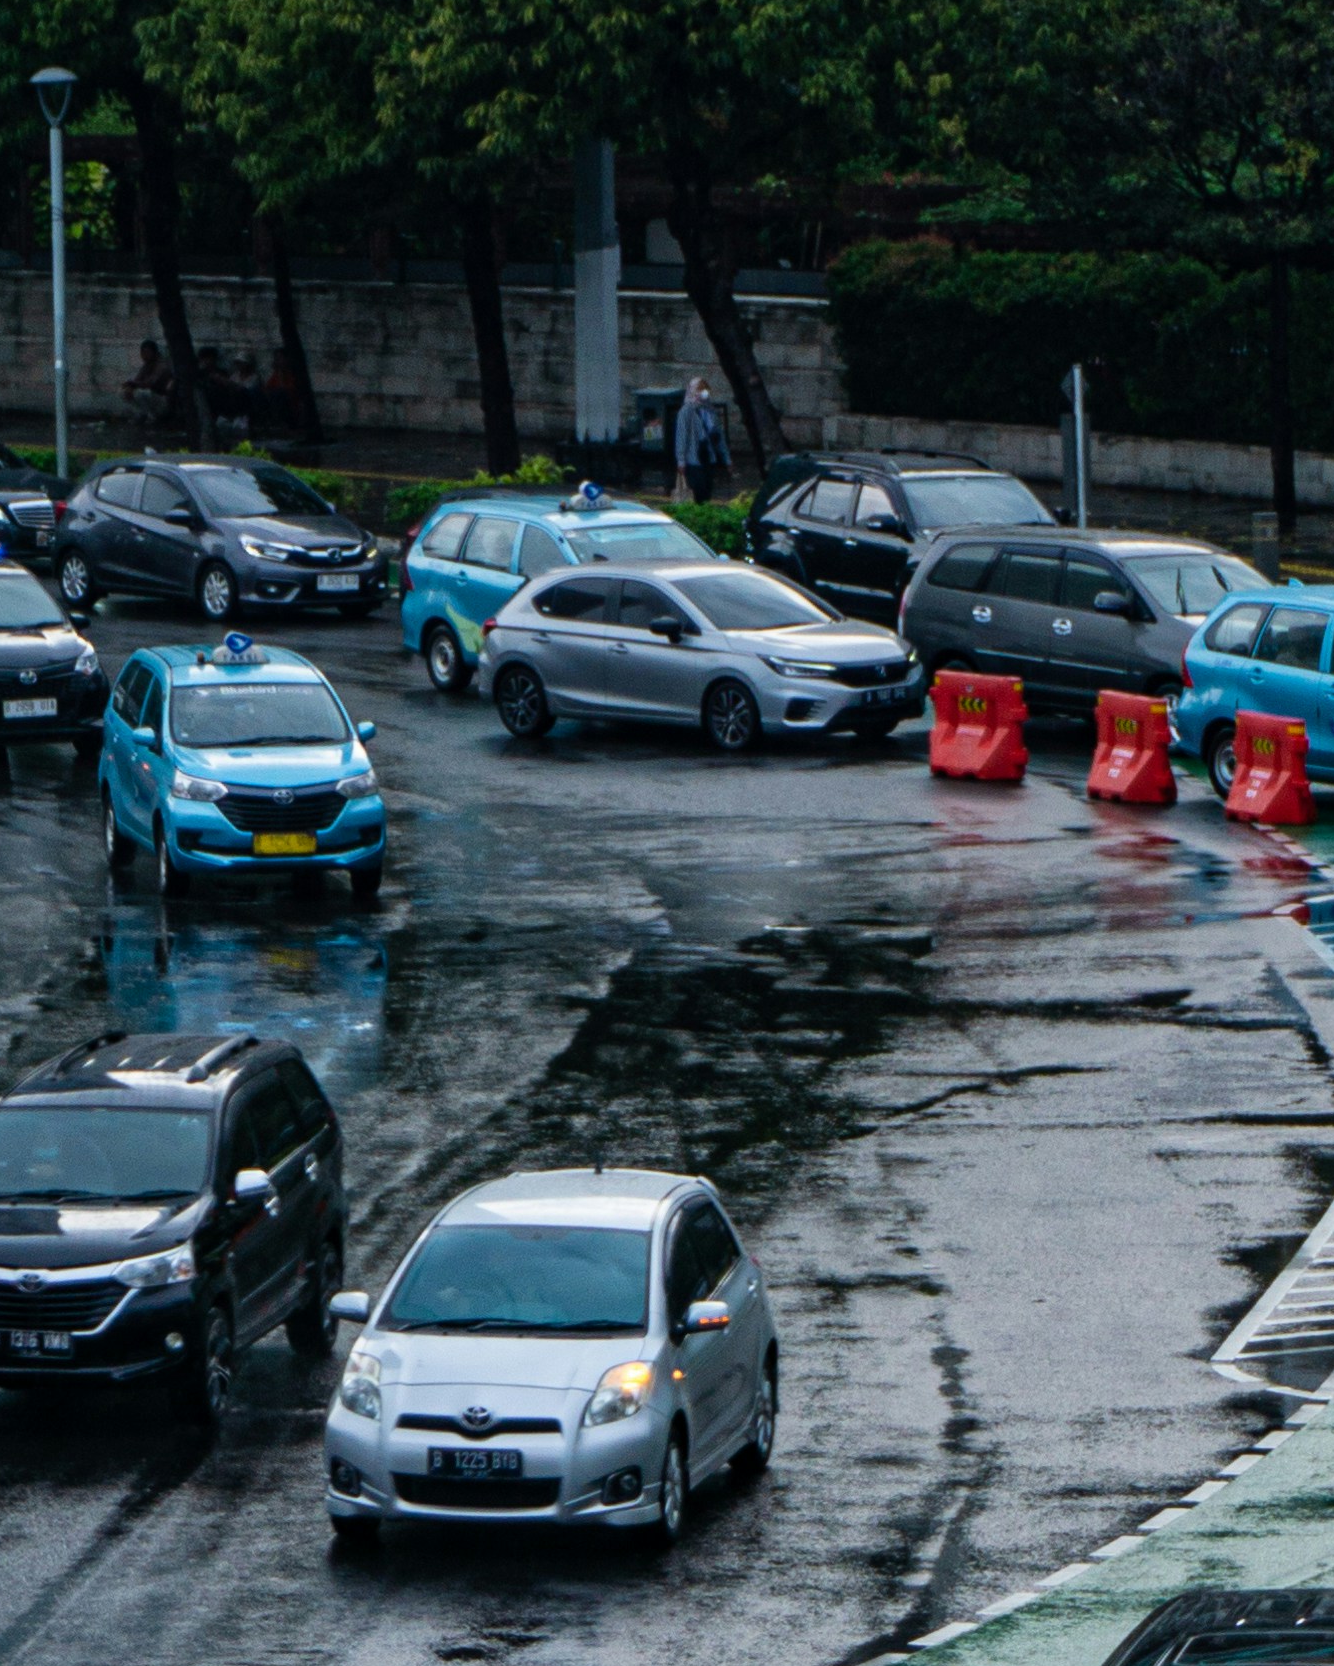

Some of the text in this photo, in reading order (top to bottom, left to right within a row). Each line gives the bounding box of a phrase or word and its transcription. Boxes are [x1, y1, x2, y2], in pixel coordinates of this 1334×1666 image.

[223, 653, 258, 663] TAKSI
[220, 685, 277, 695] Bluebird
[432, 1450, 442, 1468] B
[454, 1451, 487, 1470] 1225
